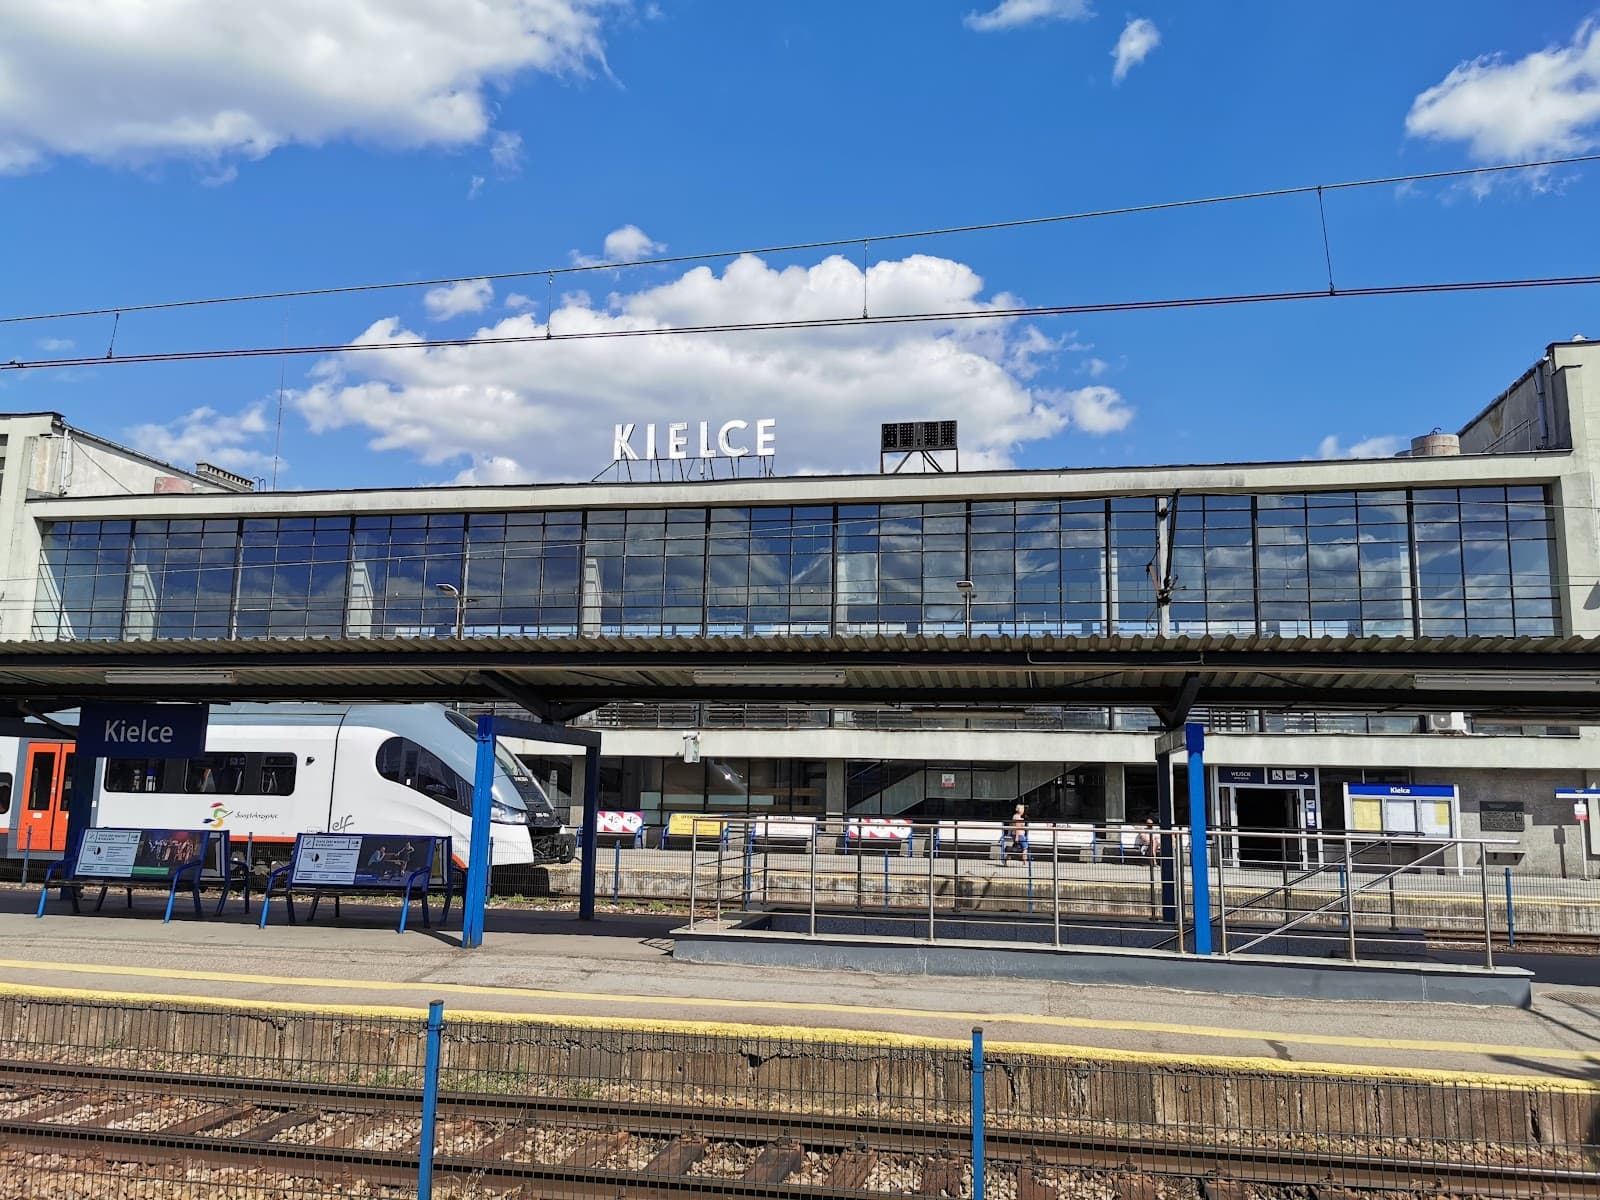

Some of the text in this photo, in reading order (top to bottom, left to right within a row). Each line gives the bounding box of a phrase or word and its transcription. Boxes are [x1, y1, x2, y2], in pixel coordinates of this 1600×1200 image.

[613, 418, 777, 461] KIELCE
[104, 719, 174, 743] Kielce
[1390, 786, 1411, 794] Kielce
[332, 814, 355, 833] elf
